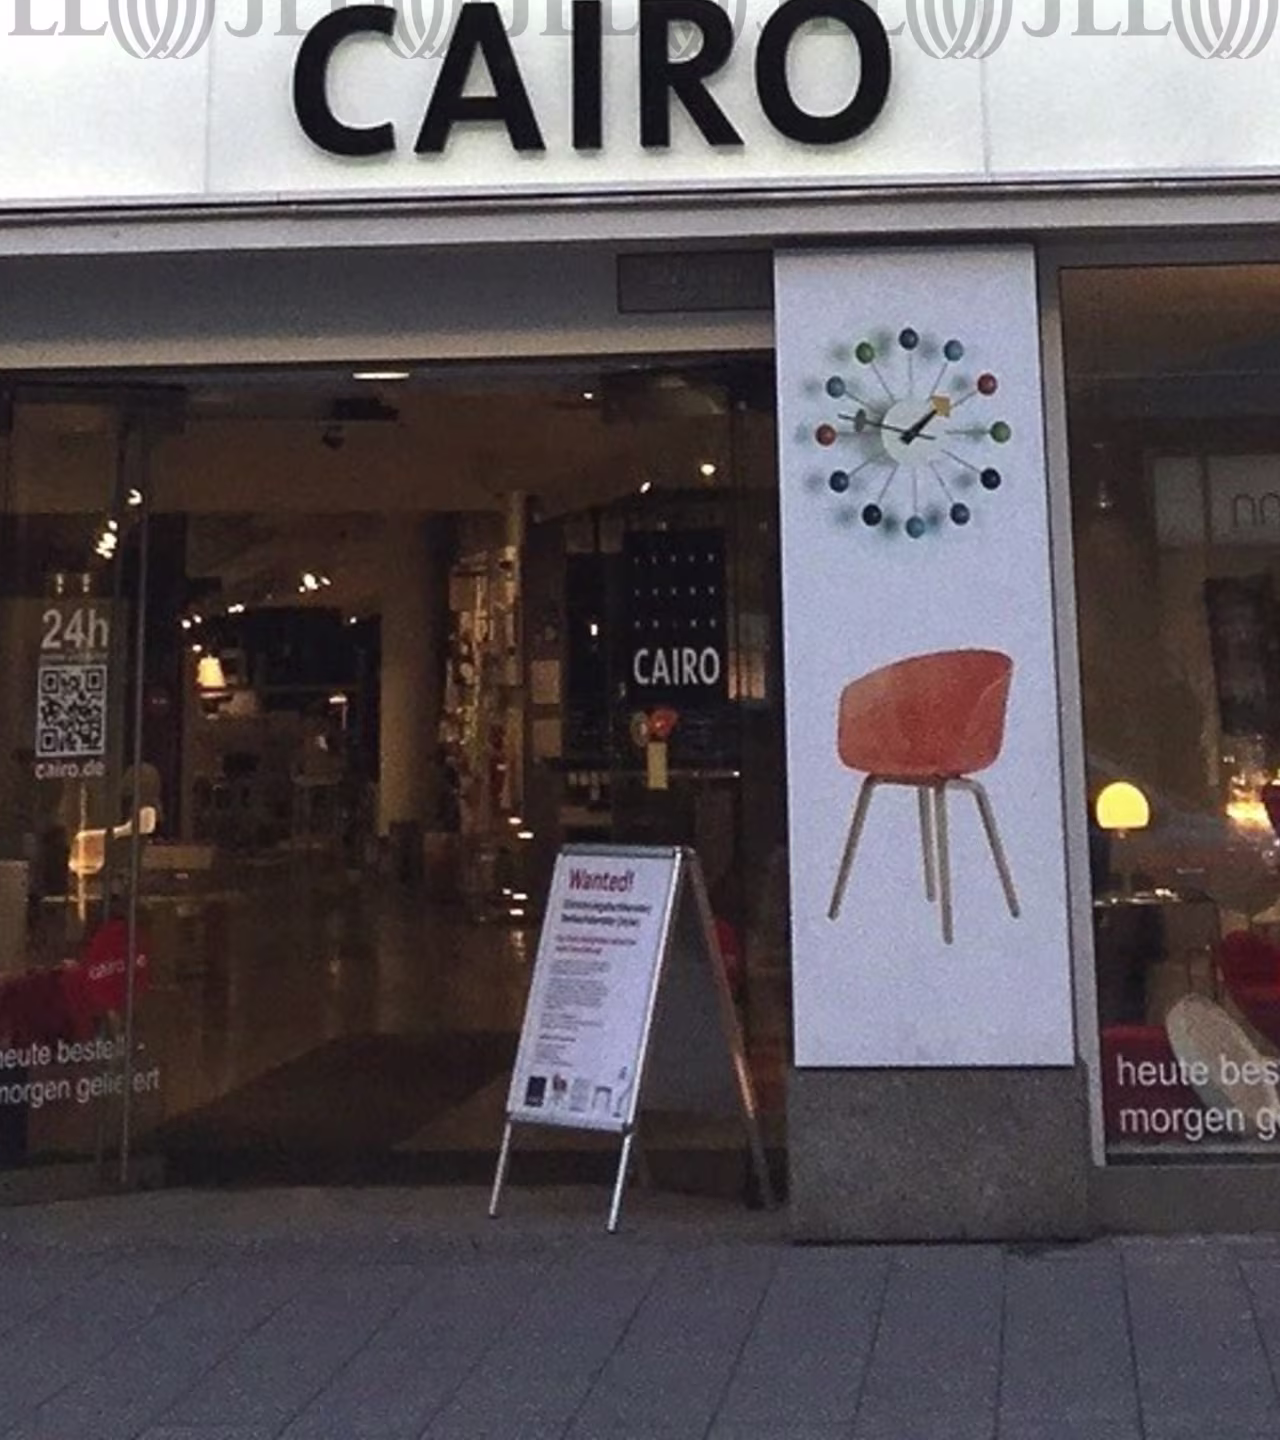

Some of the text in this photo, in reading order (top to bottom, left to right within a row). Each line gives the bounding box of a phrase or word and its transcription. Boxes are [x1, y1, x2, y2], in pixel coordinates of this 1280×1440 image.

[40, 609, 109, 649] 24h
[633, 647, 720, 685] CAIRO
[35, 759, 105, 779] cairo.de
[1117, 1054, 1209, 1086] heute
[1120, 1107, 1245, 1141] morgen
